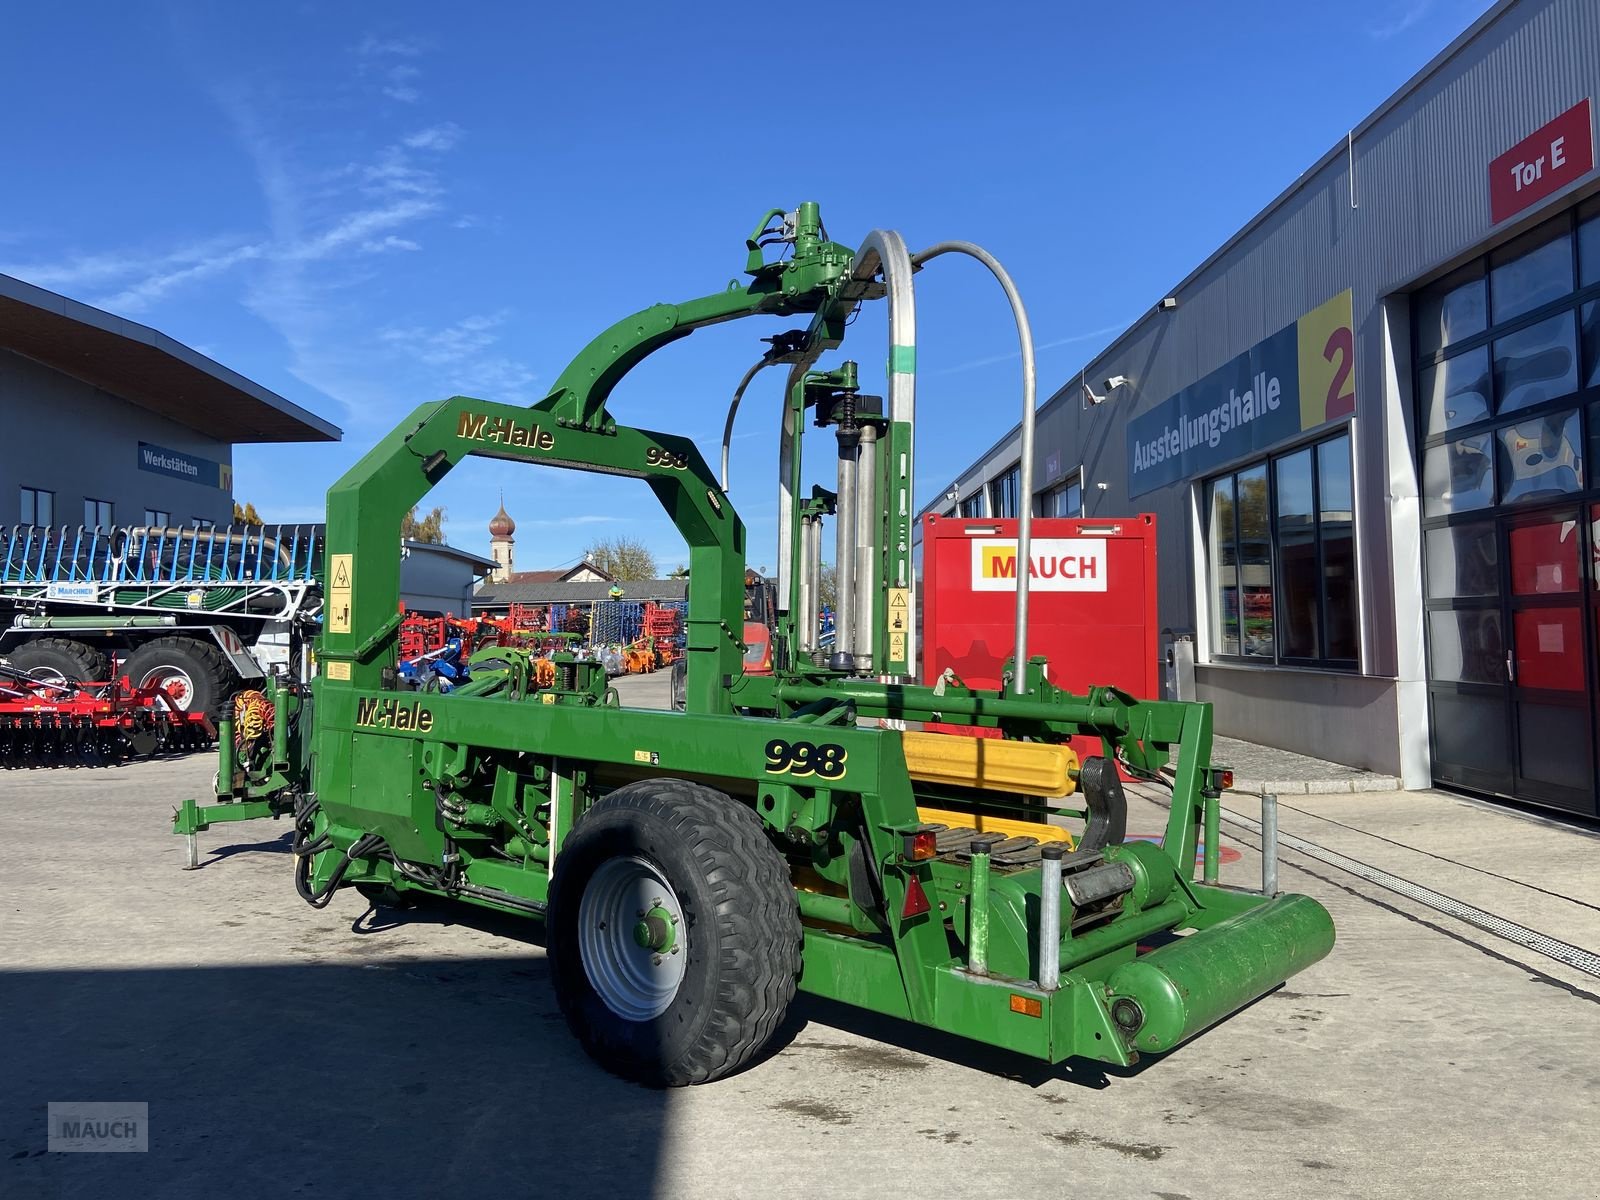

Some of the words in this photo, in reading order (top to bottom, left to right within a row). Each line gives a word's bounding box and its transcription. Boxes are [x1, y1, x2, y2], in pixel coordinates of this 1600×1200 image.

[1511, 155, 1544, 192] Tor
[1550, 136, 1566, 170] E
[1133, 371, 1281, 474] Ausstellungshalle
[1323, 326, 1355, 421] 2
[457, 411, 555, 450] McHale
[143, 449, 198, 477] Werkstätten
[646, 446, 689, 470] 998
[356, 697, 434, 733] McHale
[765, 738, 848, 780] 998
